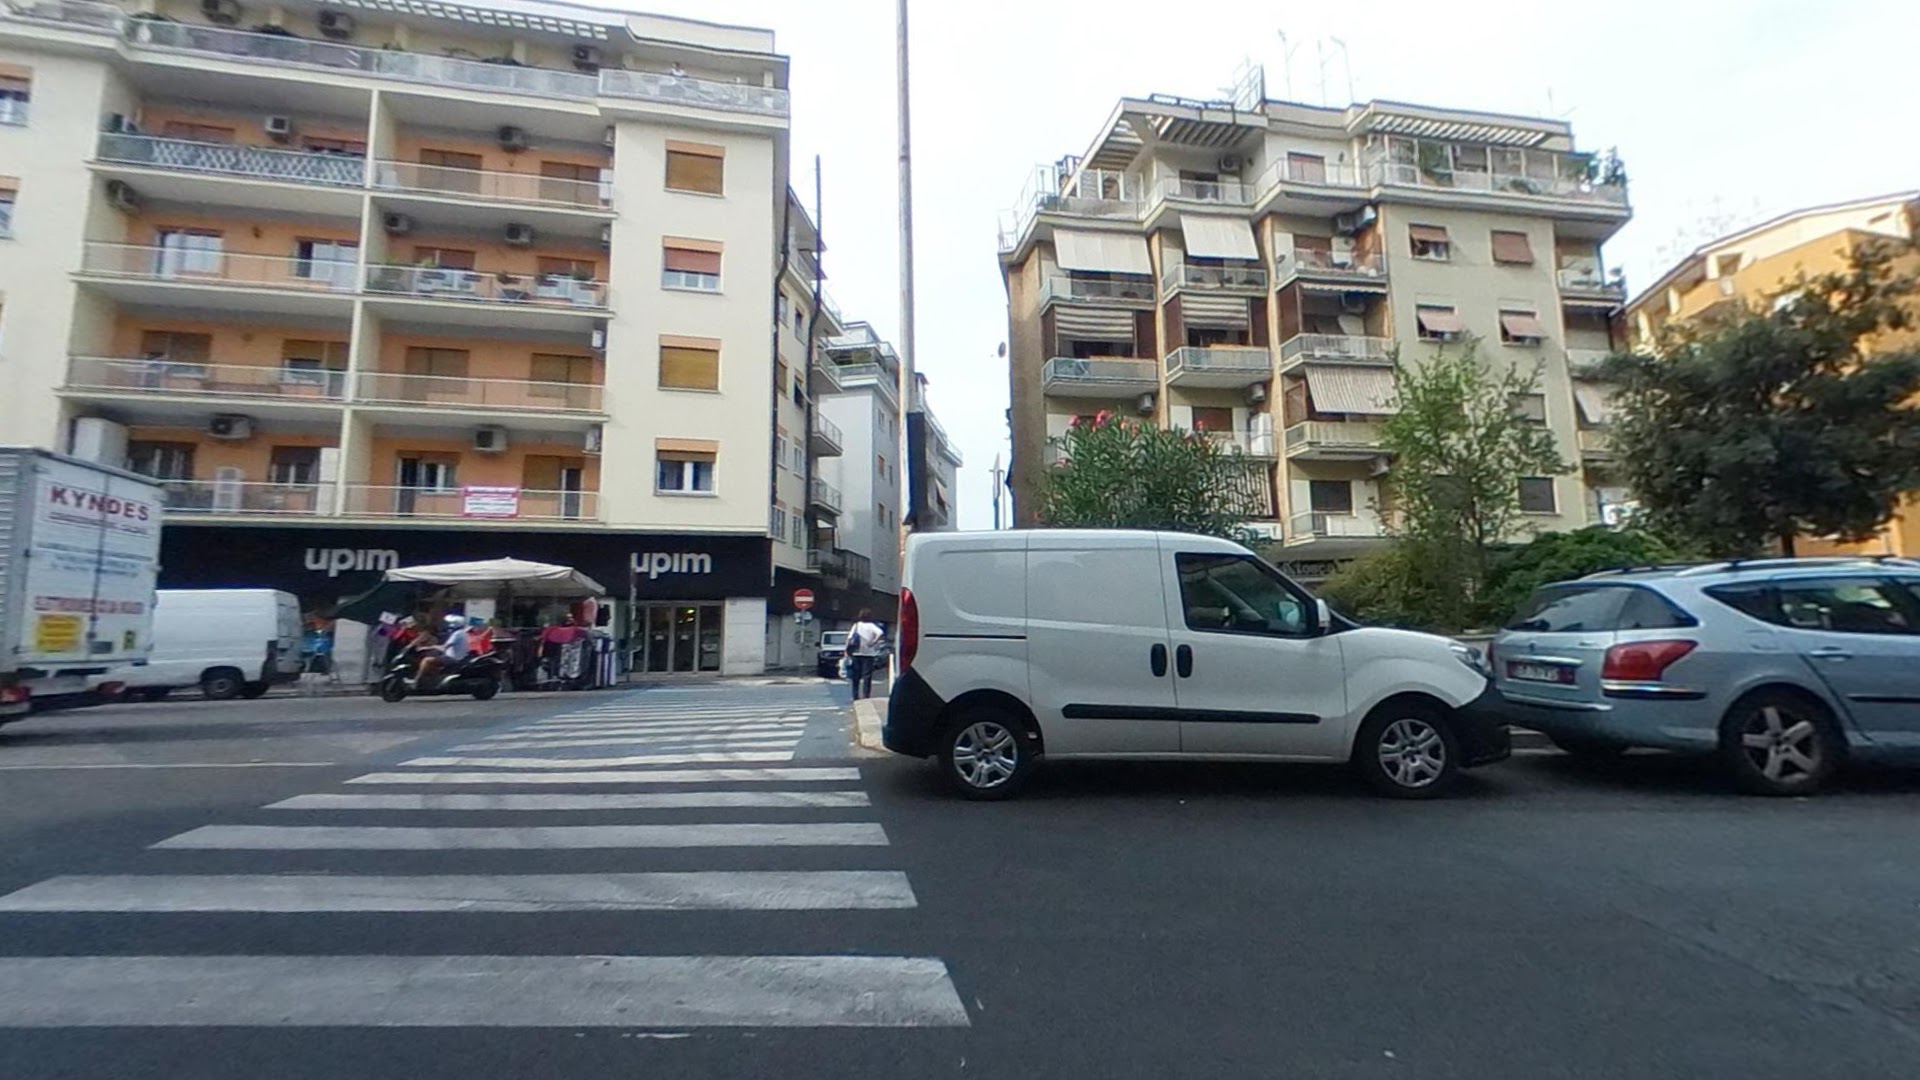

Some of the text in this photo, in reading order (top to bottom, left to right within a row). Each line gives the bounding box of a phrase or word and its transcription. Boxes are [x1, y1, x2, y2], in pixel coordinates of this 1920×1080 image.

[49, 485, 150, 521] KYNDES
[304, 547, 400, 578] upim
[630, 552, 712, 580] upim
